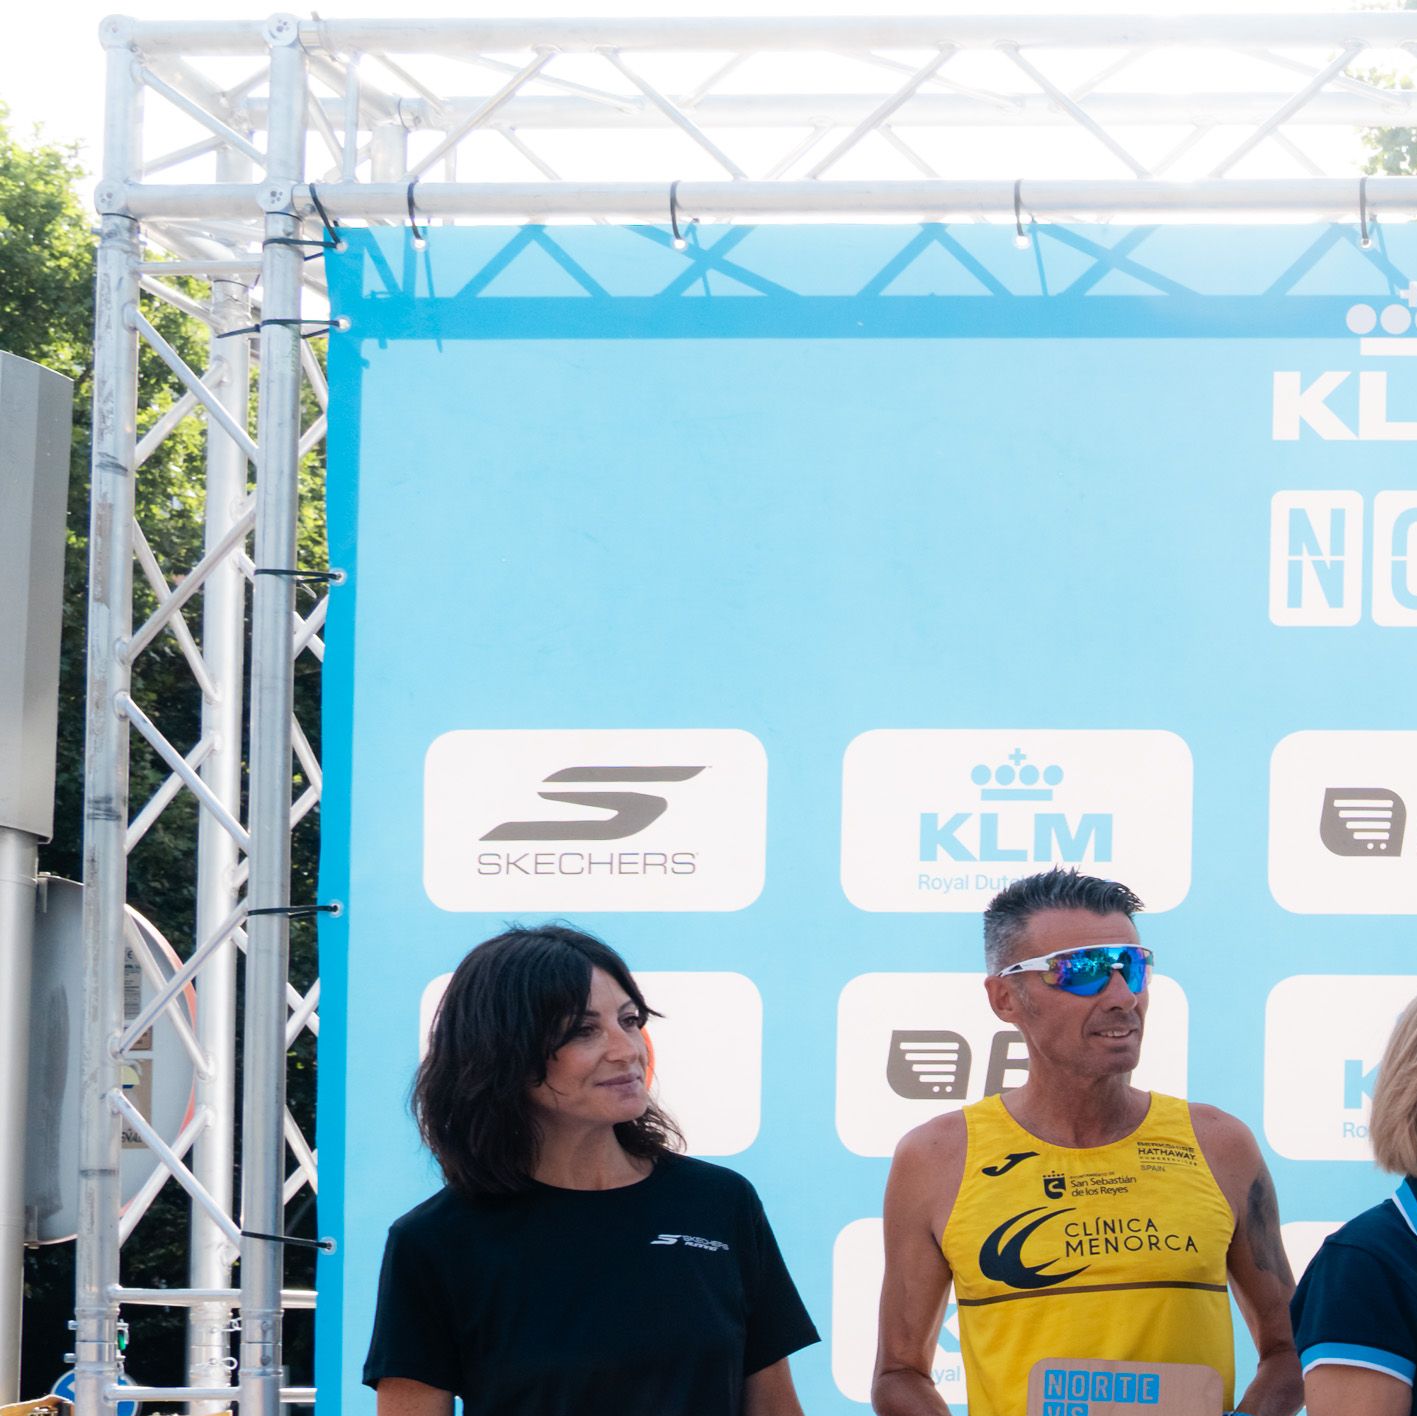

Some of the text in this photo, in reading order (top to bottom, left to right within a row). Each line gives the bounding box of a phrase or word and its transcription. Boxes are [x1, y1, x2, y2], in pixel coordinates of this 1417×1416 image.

[918, 812, 1113, 862] KLM
[478, 853, 696, 875] SKECHERS
[918, 874, 1025, 893] Royal Dut
[1138, 1148, 1197, 1161] HATHAWAY
[1071, 1179, 1089, 1188] San
[1091, 1175, 1137, 1187] Sebastián
[1071, 1186, 1129, 1197] de los Reyes
[1064, 1217, 1158, 1238] CLÍNICA
[1065, 1235, 1198, 1258] MENORCA
[934, 1365, 960, 1385] yal
[1046, 1371, 1156, 1401] NORTE
